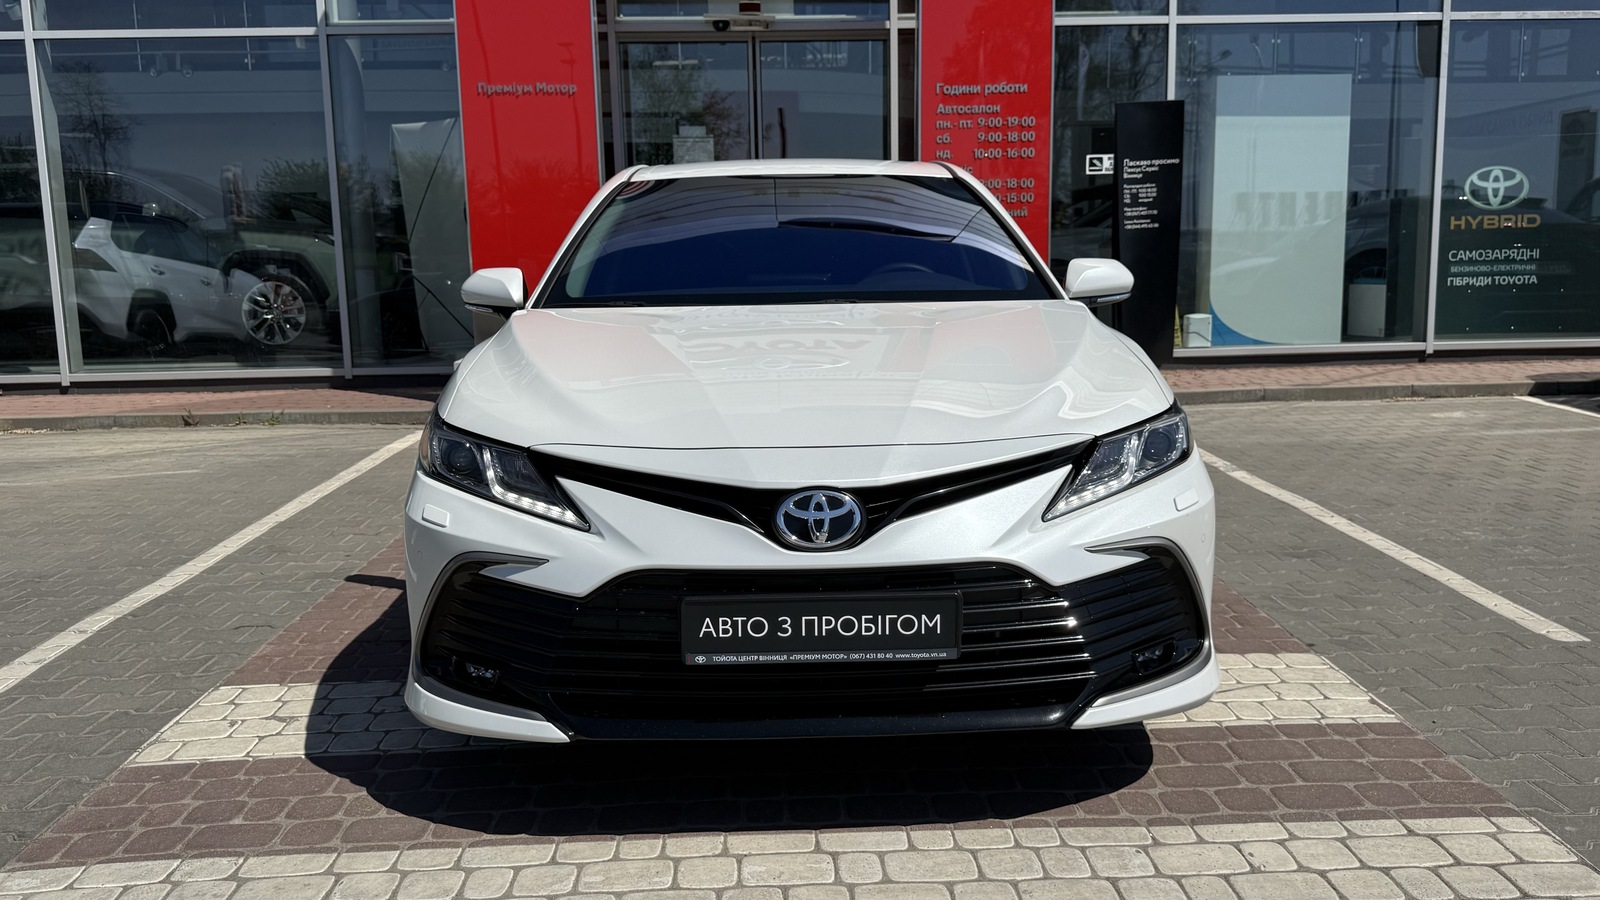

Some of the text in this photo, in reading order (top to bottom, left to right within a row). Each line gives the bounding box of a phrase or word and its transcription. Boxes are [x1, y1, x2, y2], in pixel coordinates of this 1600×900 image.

[477, 82, 577, 95] Преміум Мотор
[936, 81, 1028, 96] Години роботи
[937, 103, 1000, 115] Автосалон
[978, 116, 1036, 128] 9:00-19:00
[936, 131, 1036, 144] сб. 9:00-18:00
[936, 147, 1035, 160] нд. 10:00-16:00
[1449, 214, 1541, 230] HYBRID
[1448, 248, 1540, 262] САМОЗАРЯДНІ
[1450, 264, 1536, 273] БЕНЗИНОВО-ЕЛЕКТРИЧНІ
[1447, 275, 1538, 287] ГІБРИДИ TOYOTA
[699, 614, 941, 638] АВТО З ПРОБІГОМ
[849, 652, 865, 661] (067)
